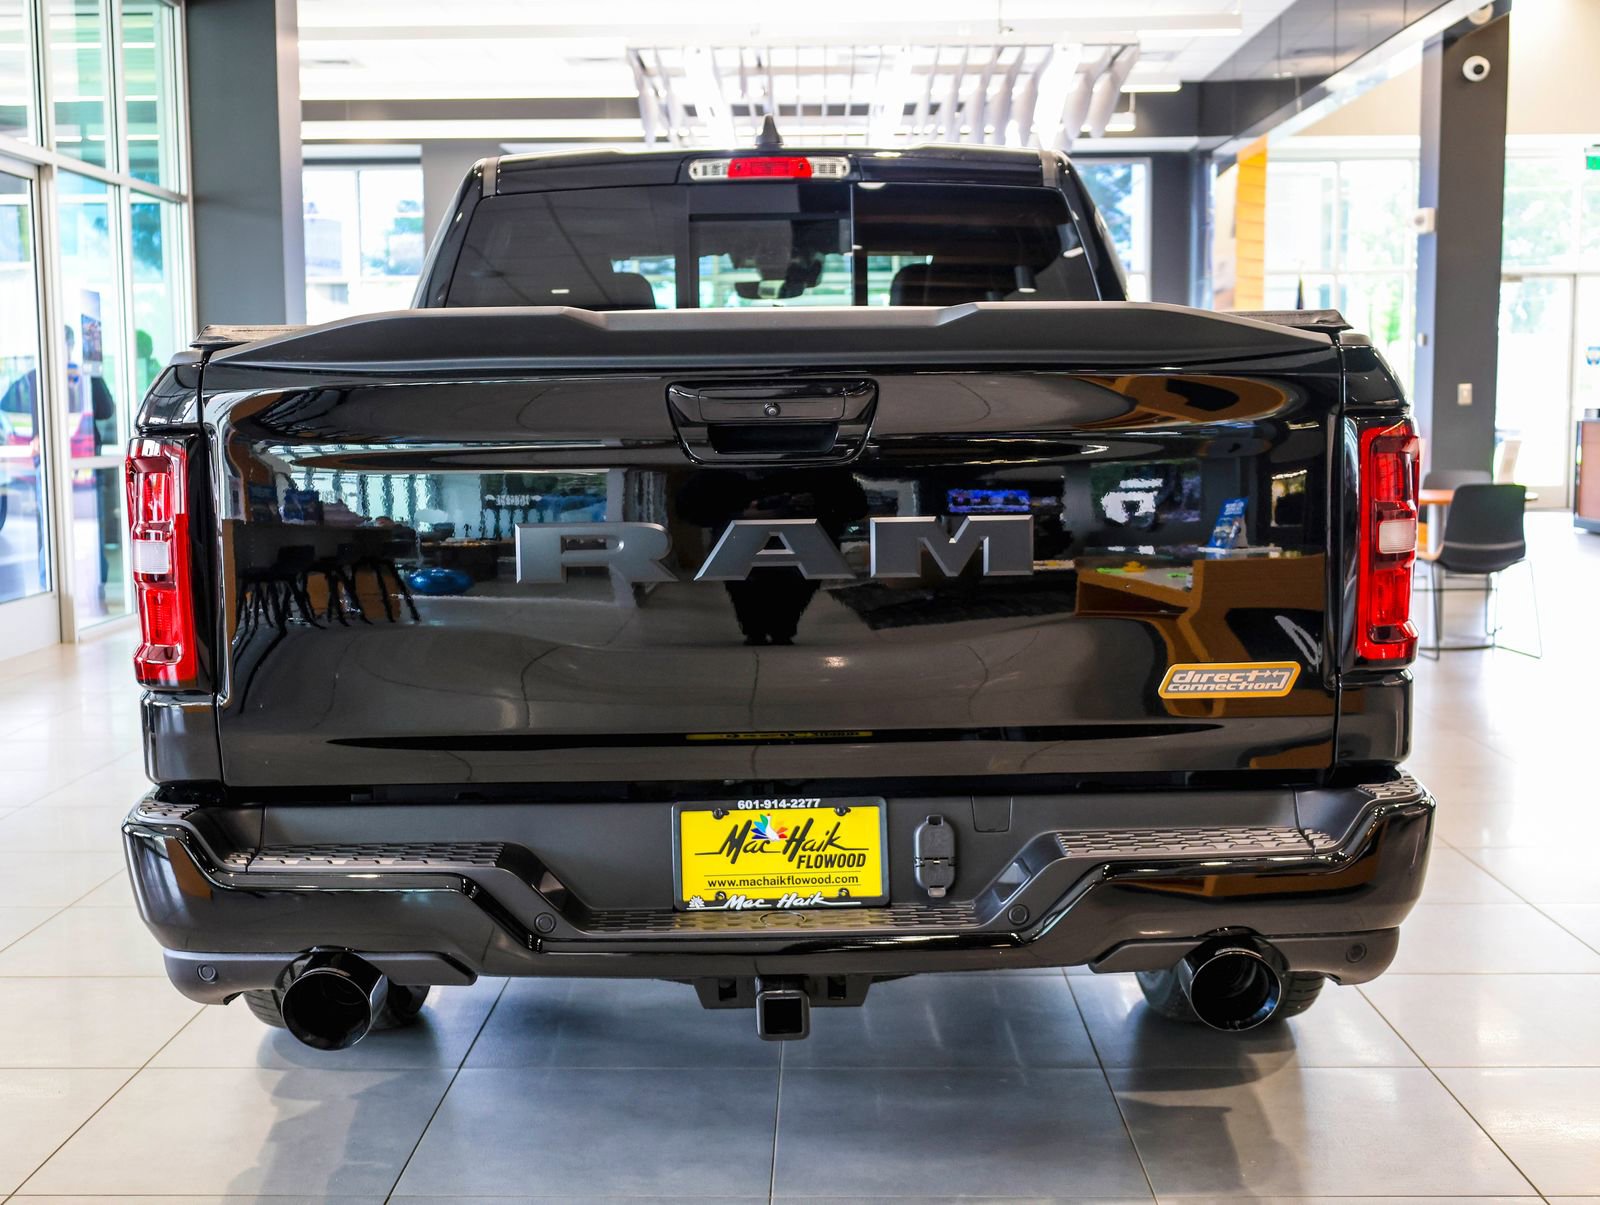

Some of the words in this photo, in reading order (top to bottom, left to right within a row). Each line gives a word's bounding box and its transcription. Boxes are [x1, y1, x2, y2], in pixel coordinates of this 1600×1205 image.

[515, 514, 1035, 584] RAM
[1171, 669, 1273, 684] direct
[1167, 681, 1288, 692] connection
[737, 798, 821, 810] 601-914-2277
[694, 819, 781, 865] Mac
[782, 817, 869, 863] Haik
[796, 852, 867, 869] FLOWOOD
[707, 874, 859, 888] www.machaikflowood.com
[708, 894, 772, 910] Mac
[776, 891, 861, 908] Haik
